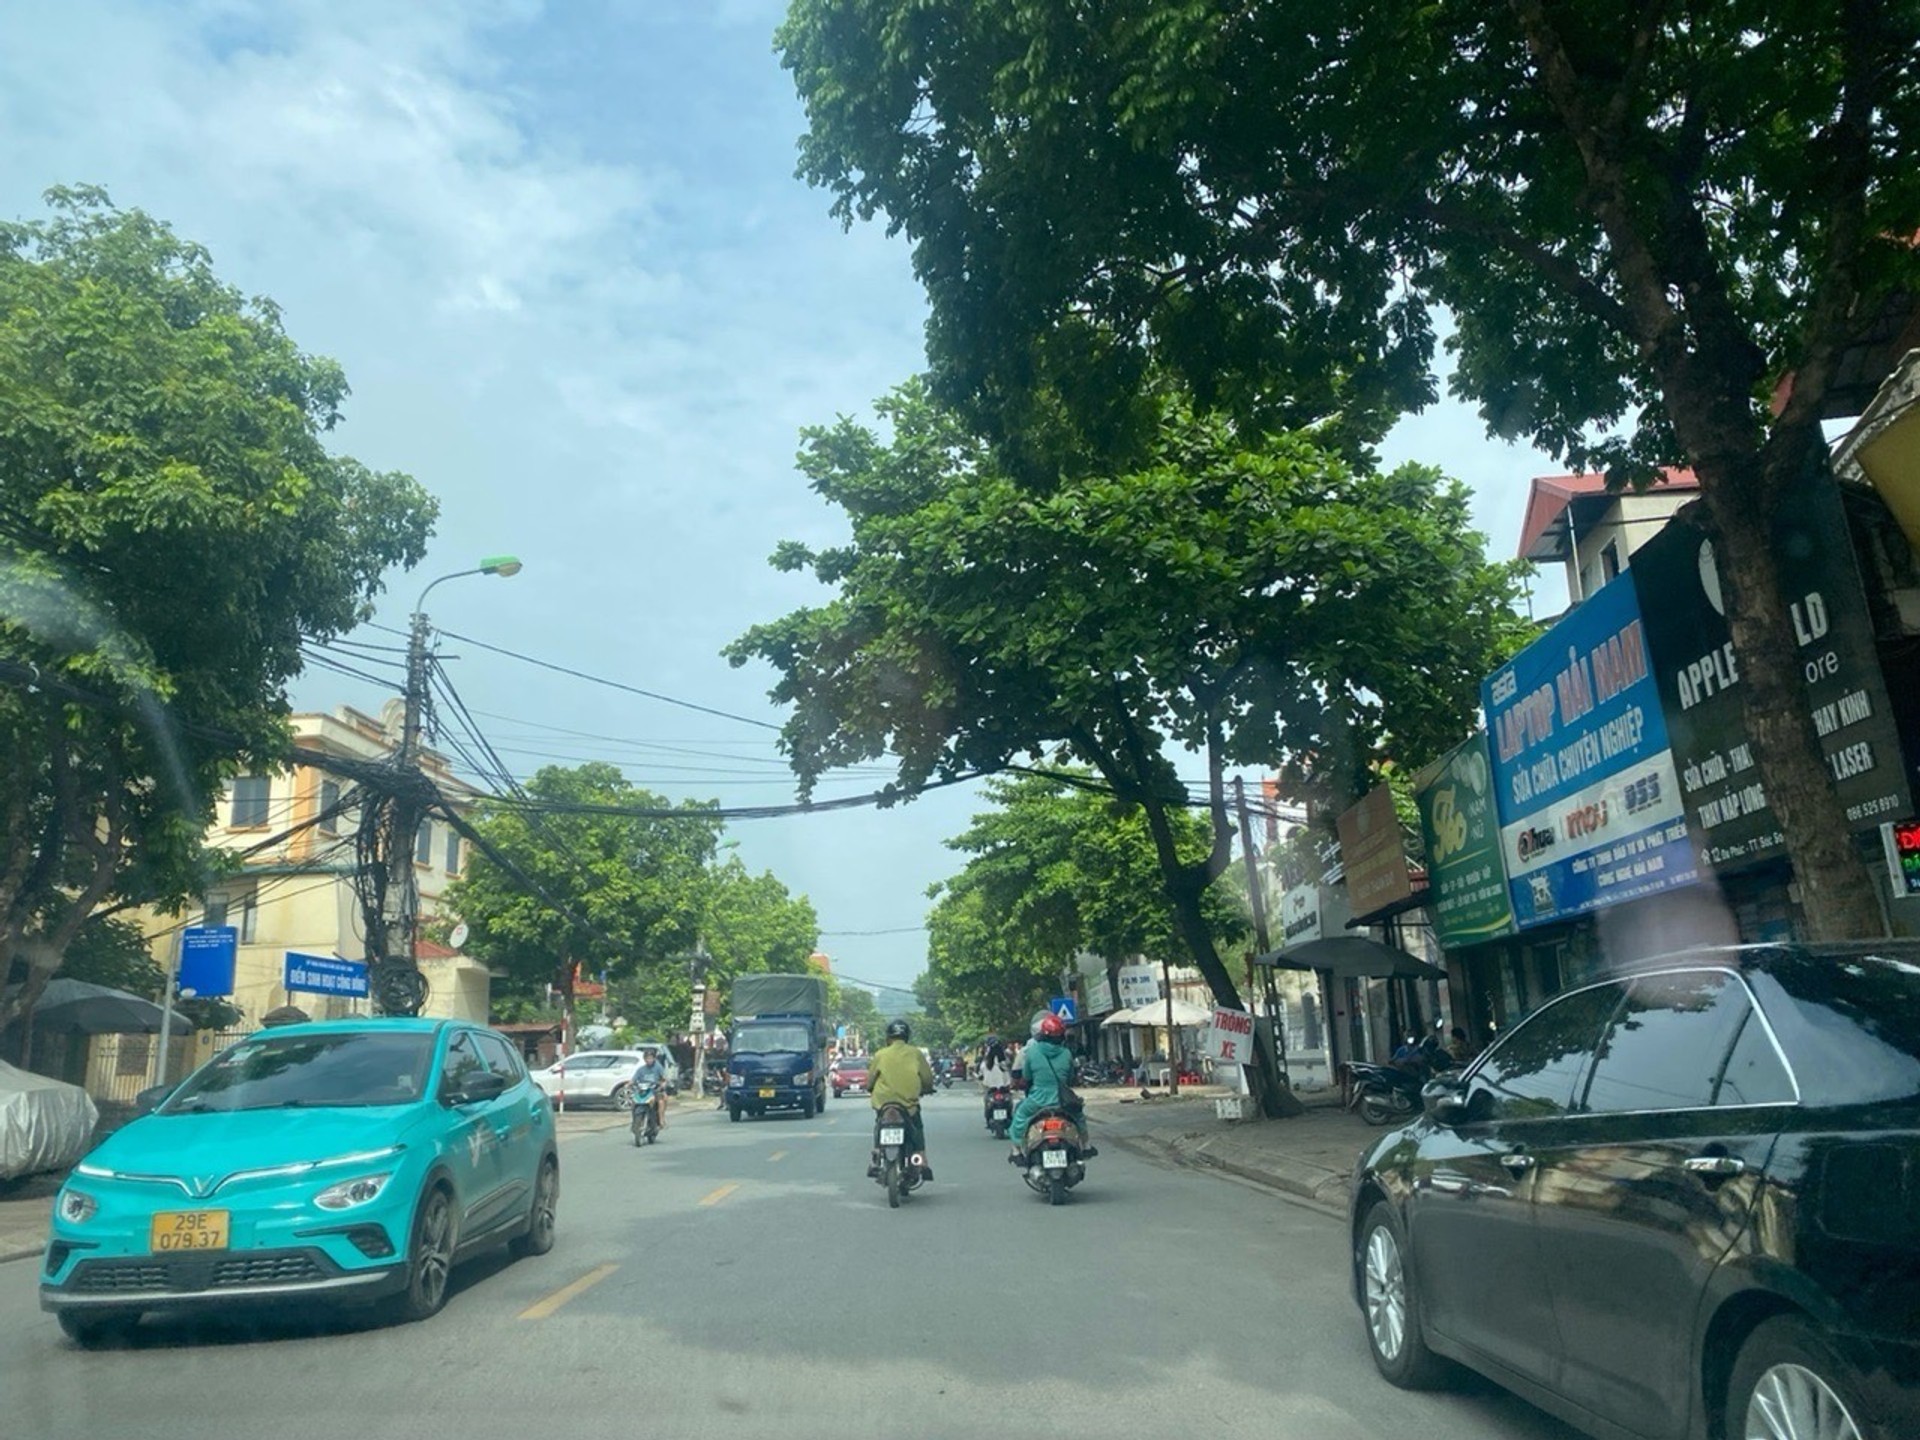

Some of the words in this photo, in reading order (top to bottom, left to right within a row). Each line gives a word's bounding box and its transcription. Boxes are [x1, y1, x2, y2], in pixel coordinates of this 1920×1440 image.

[1677, 641, 1739, 711] APPLE
[1805, 651, 1839, 684] ore
[1495, 683, 1555, 763] LAPTOP
[1591, 618, 1649, 705] NAM
[1837, 688, 1872, 727] KÍNH
[1512, 764, 1533, 805] SỬA
[1532, 752, 1560, 796] CHỮA
[1558, 729, 1600, 782] CHUYÊN
[1600, 703, 1644, 760] NGHIỆP
[1831, 741, 1876, 781] LASER
[1215, 1011, 1251, 1035] TRÔNG
[1220, 1040, 1237, 1060] XE
[176, 1213, 208, 1230] 29E
[160, 1231, 220, 1250] 079.37
